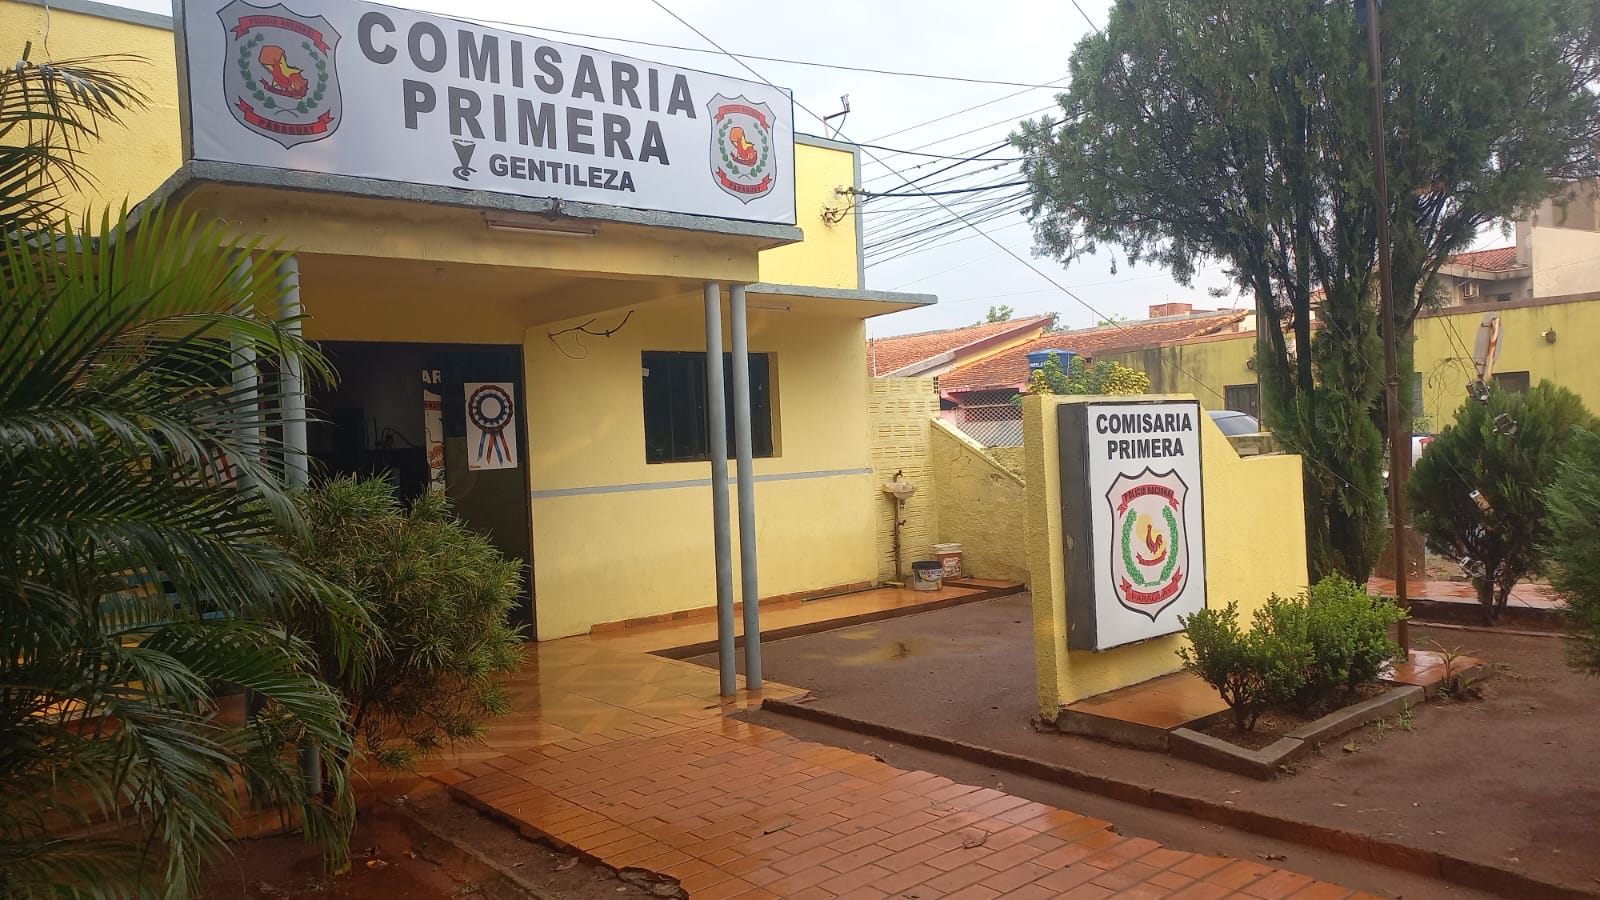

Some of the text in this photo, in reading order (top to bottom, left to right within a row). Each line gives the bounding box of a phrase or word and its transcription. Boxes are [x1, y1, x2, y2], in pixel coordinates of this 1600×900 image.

[357, 11, 697, 120] COMISARIA
[403, 78, 670, 166] PRIMERA
[489, 153, 636, 192] GENTILEZA
[1096, 413, 1193, 435] COMISARIA
[1107, 437, 1185, 460] PRIMERA
